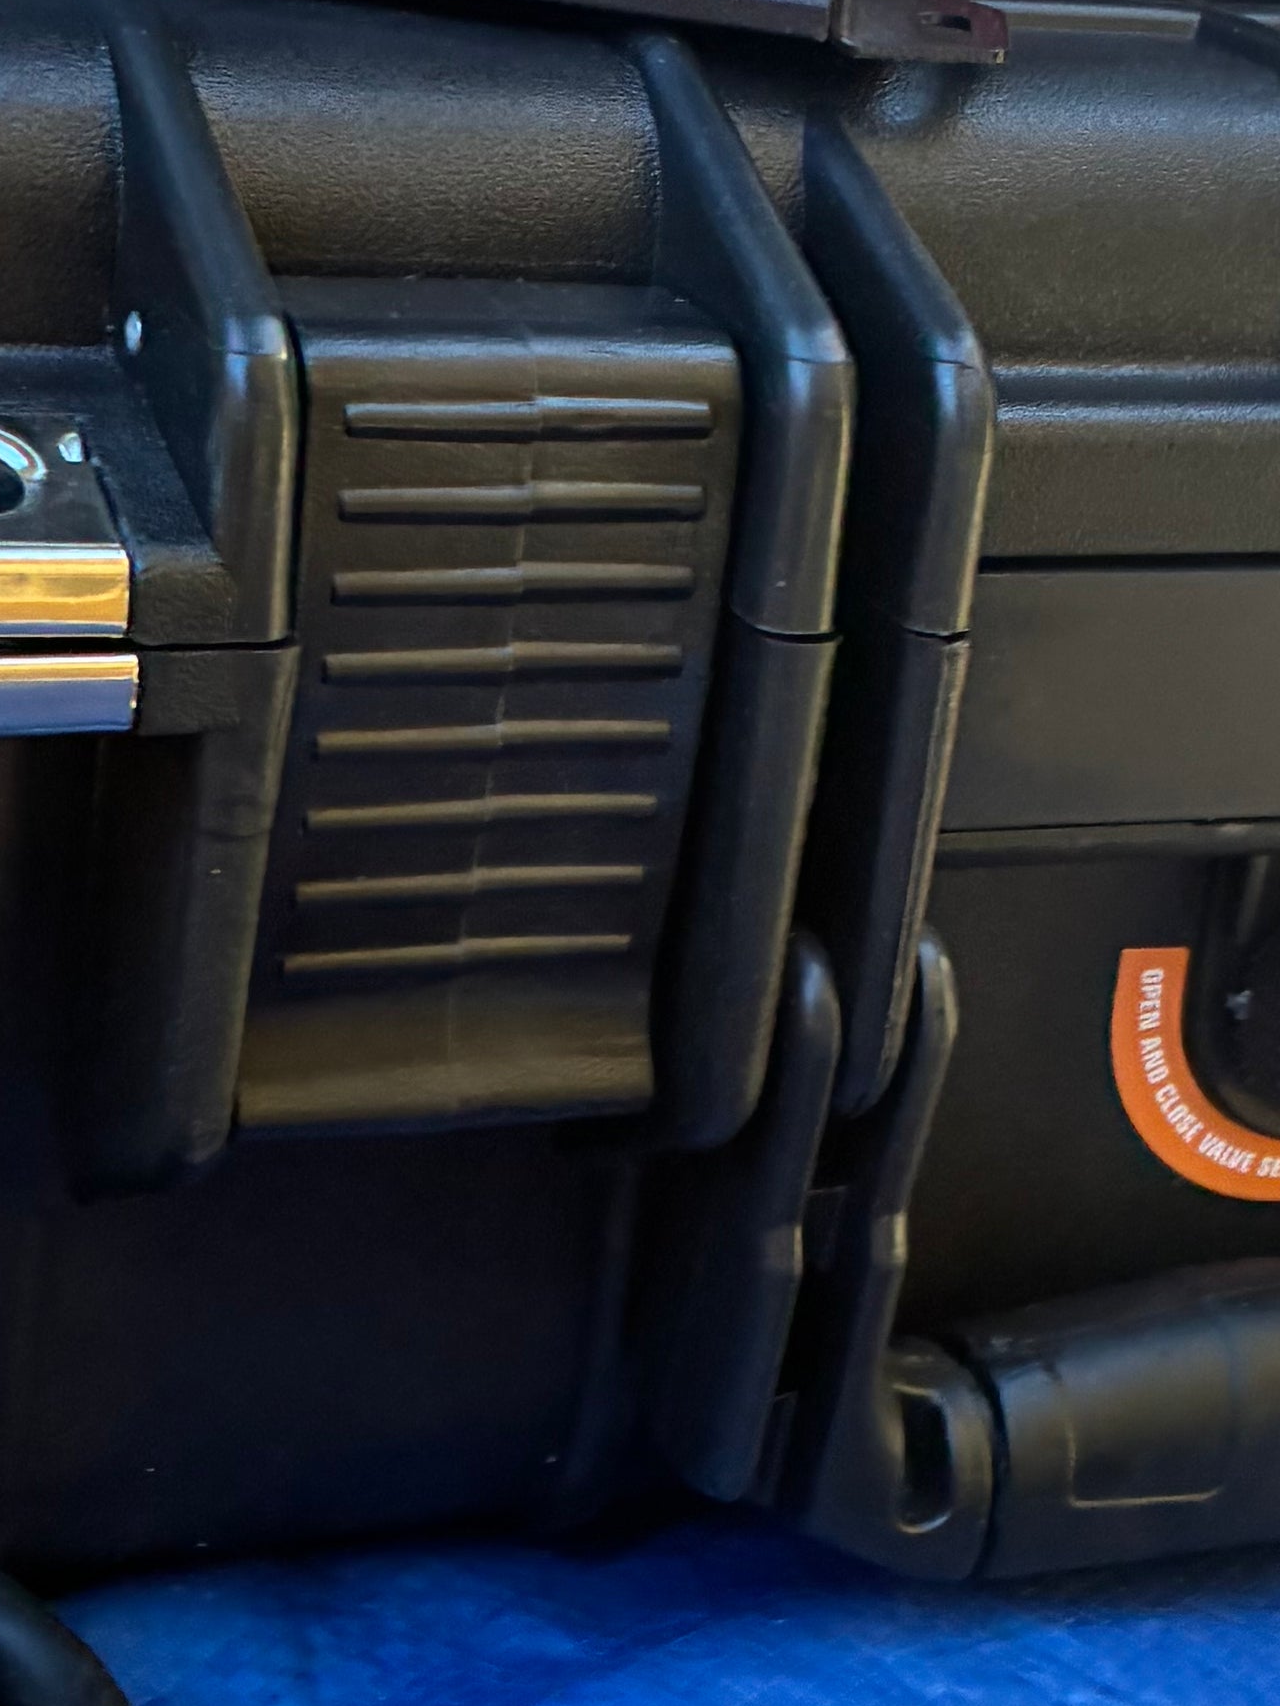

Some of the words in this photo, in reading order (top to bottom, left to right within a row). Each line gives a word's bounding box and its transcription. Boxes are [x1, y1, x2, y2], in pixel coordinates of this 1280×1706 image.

[1138, 967, 1165, 1032] OPEN
[1140, 1036, 1170, 1085] AND
[1154, 1083, 1204, 1143] CLOSE
[1197, 1132, 1257, 1175] VALVE
